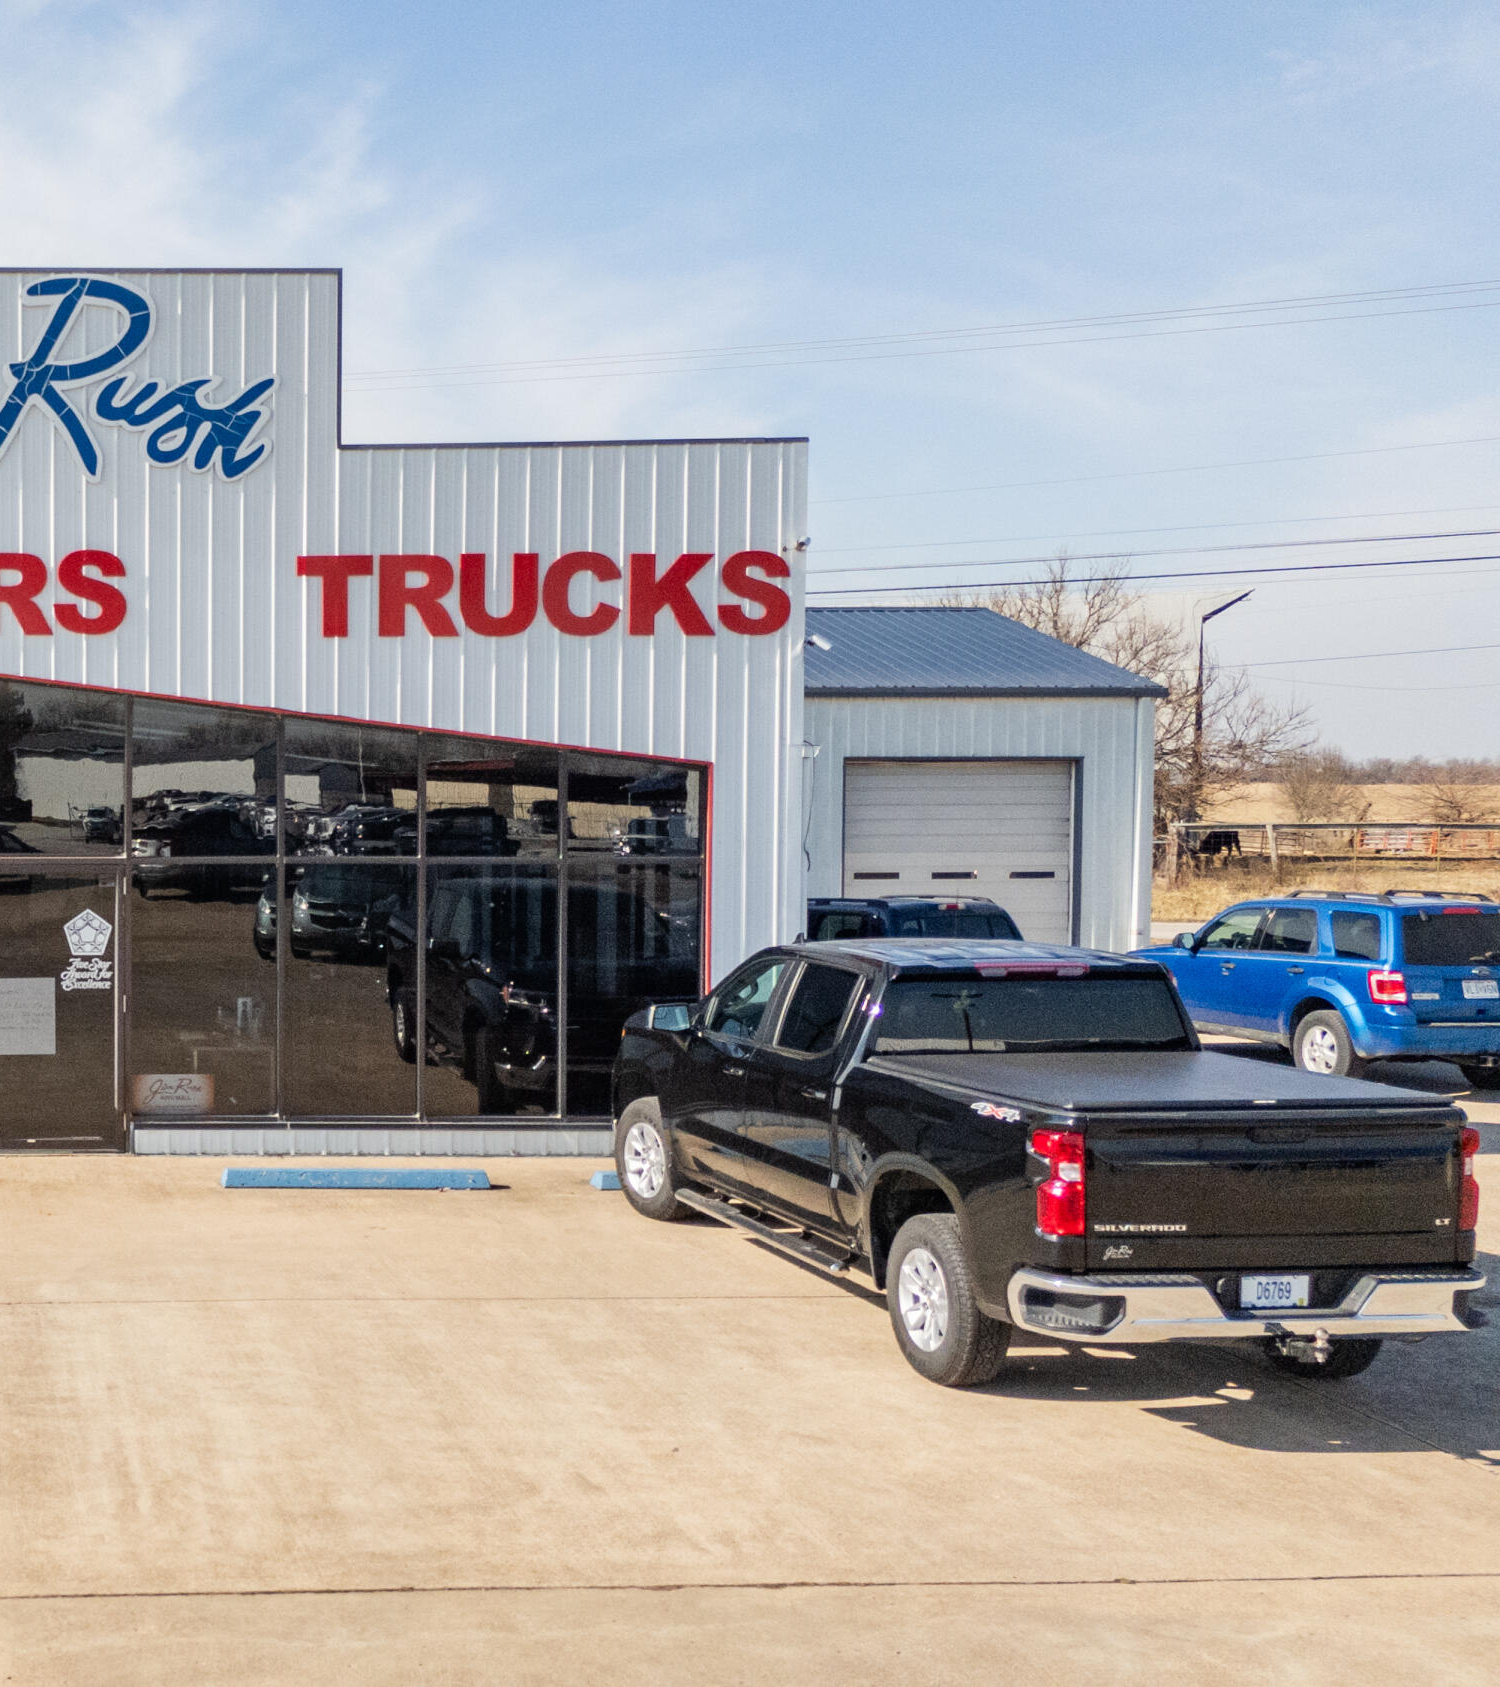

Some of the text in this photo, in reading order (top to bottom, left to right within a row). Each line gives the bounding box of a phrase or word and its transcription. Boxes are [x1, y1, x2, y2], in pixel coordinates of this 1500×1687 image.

[296, 550, 792, 638] TRUCKS
[60, 968, 99, 980] Award
[60, 979, 112, 991] Excellence
[1093, 1223, 1188, 1232] SILVERADO
[1256, 1281, 1292, 1300] D6769
